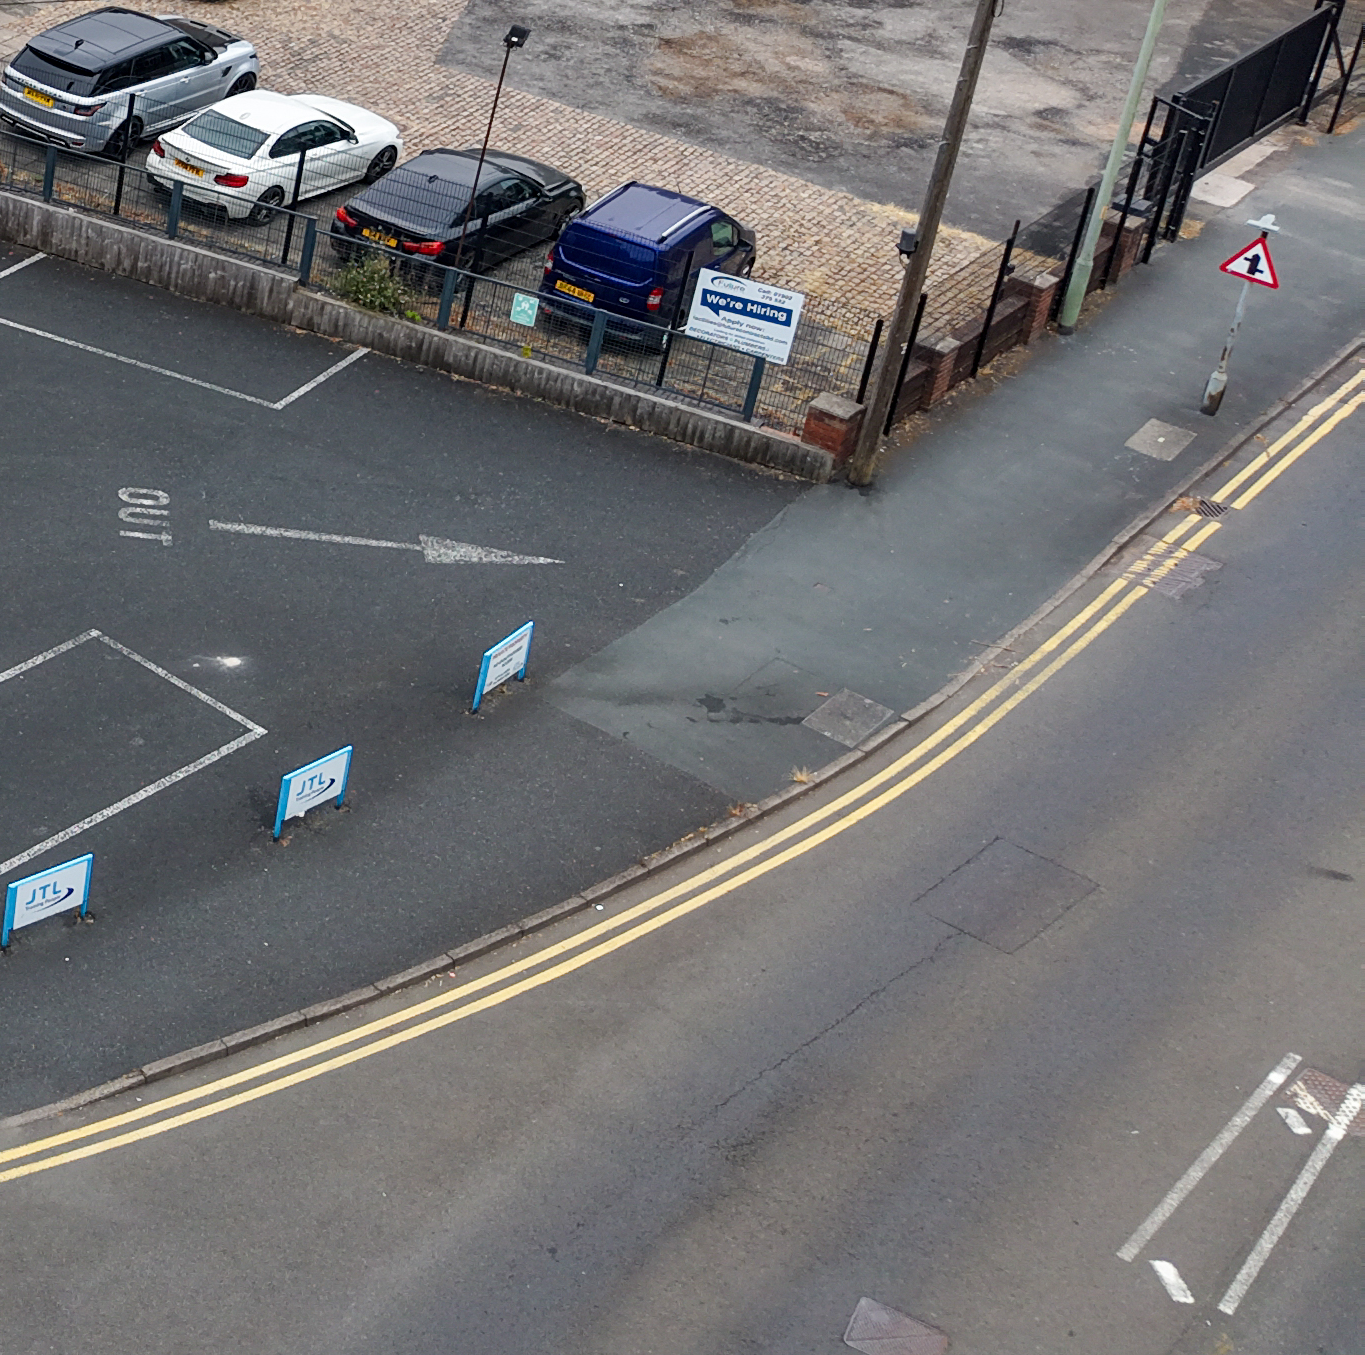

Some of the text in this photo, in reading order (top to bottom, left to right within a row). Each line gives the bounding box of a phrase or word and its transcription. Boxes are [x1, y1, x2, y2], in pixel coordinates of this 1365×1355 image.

[718, 279, 746, 292] Future
[706, 293, 787, 322] We're Hiring
[721, 315, 744, 327] Apply
[117, 487, 173, 546] OUT
[296, 772, 326, 797] JTL
[25, 881, 62, 906] JTL
